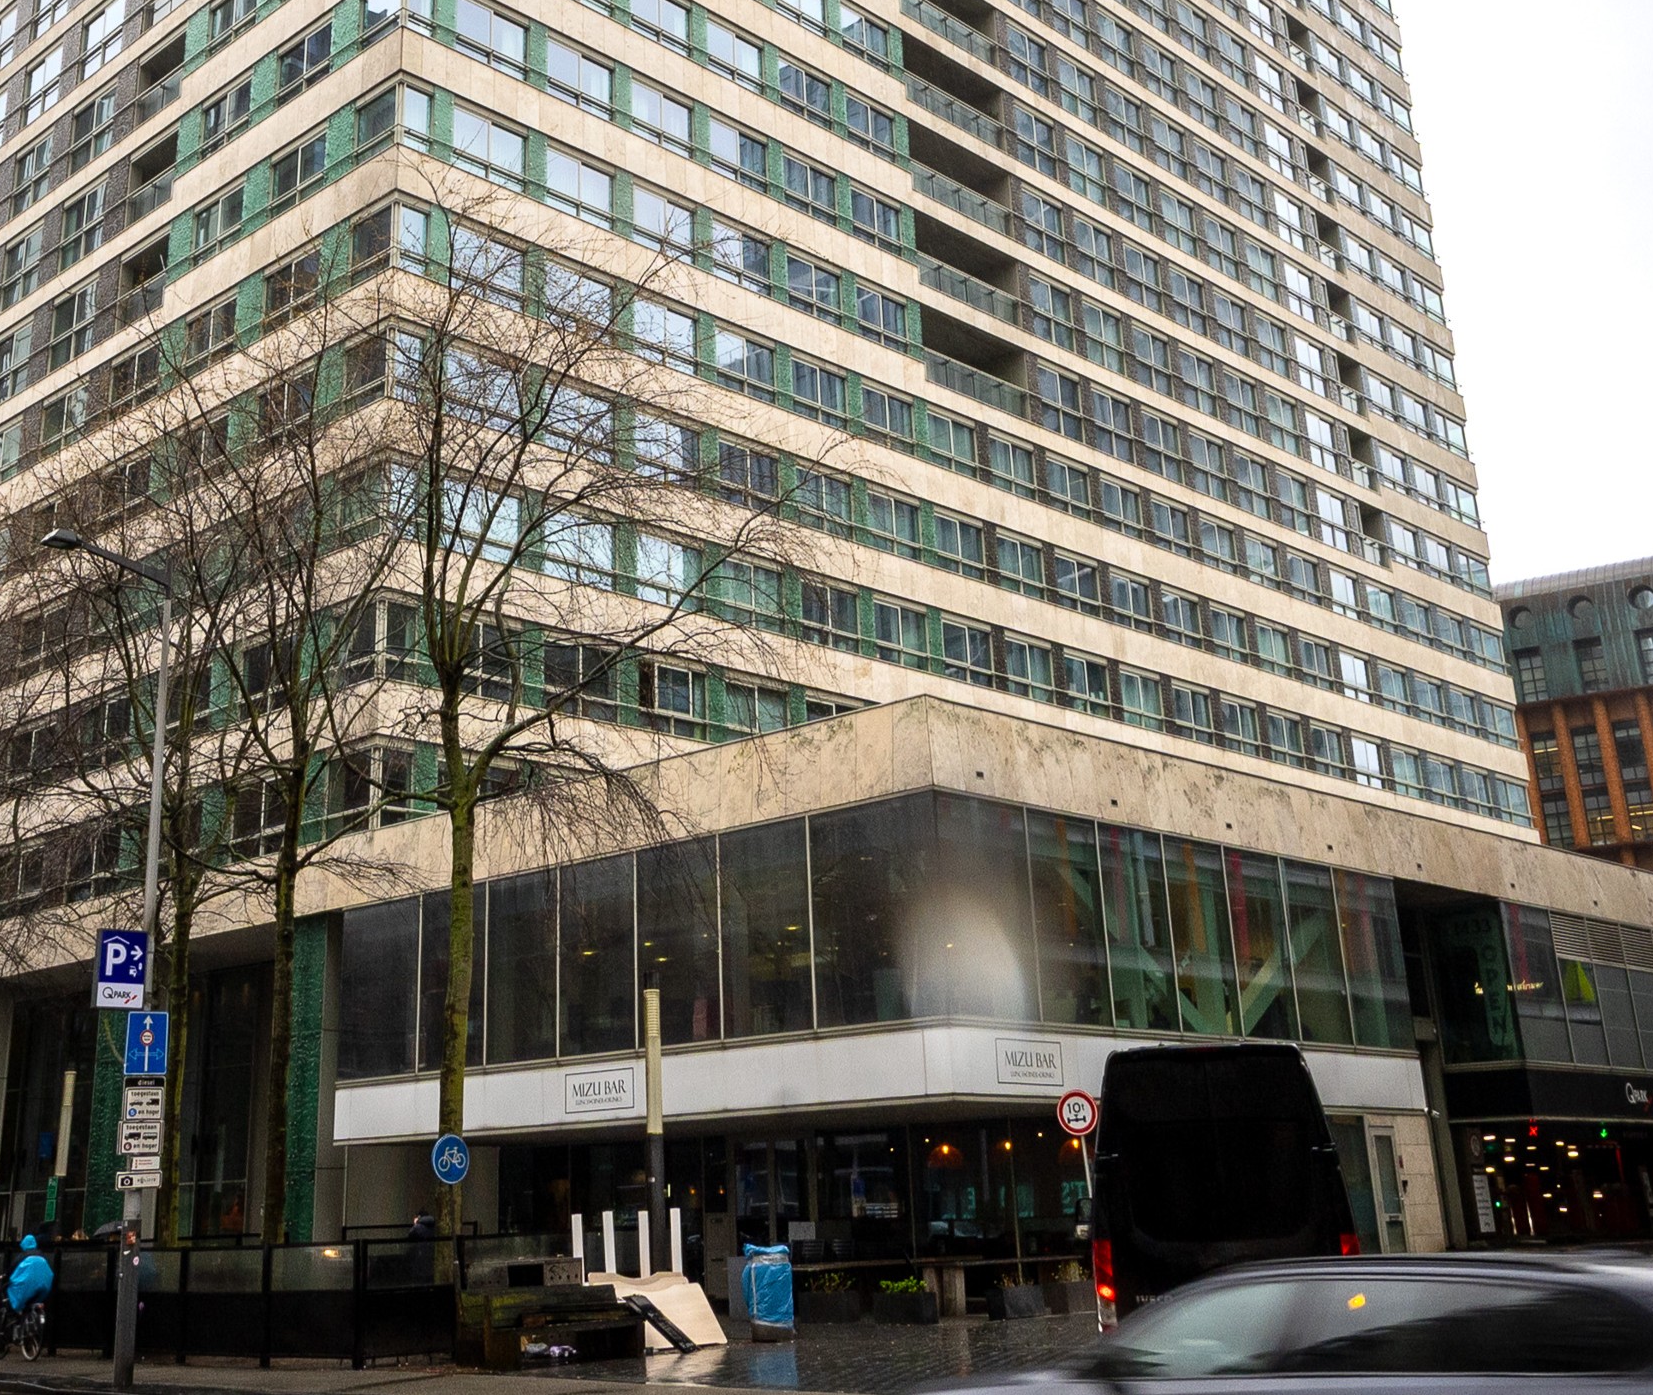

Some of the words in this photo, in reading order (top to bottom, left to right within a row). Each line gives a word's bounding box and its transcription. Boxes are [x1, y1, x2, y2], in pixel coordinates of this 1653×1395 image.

[105, 943, 127, 976] P
[1005, 1050, 1033, 1067] MIZU
[1035, 1052, 1057, 1069] BAR
[572, 1081, 601, 1098] MIZU
[604, 1079, 626, 1095] BAR
